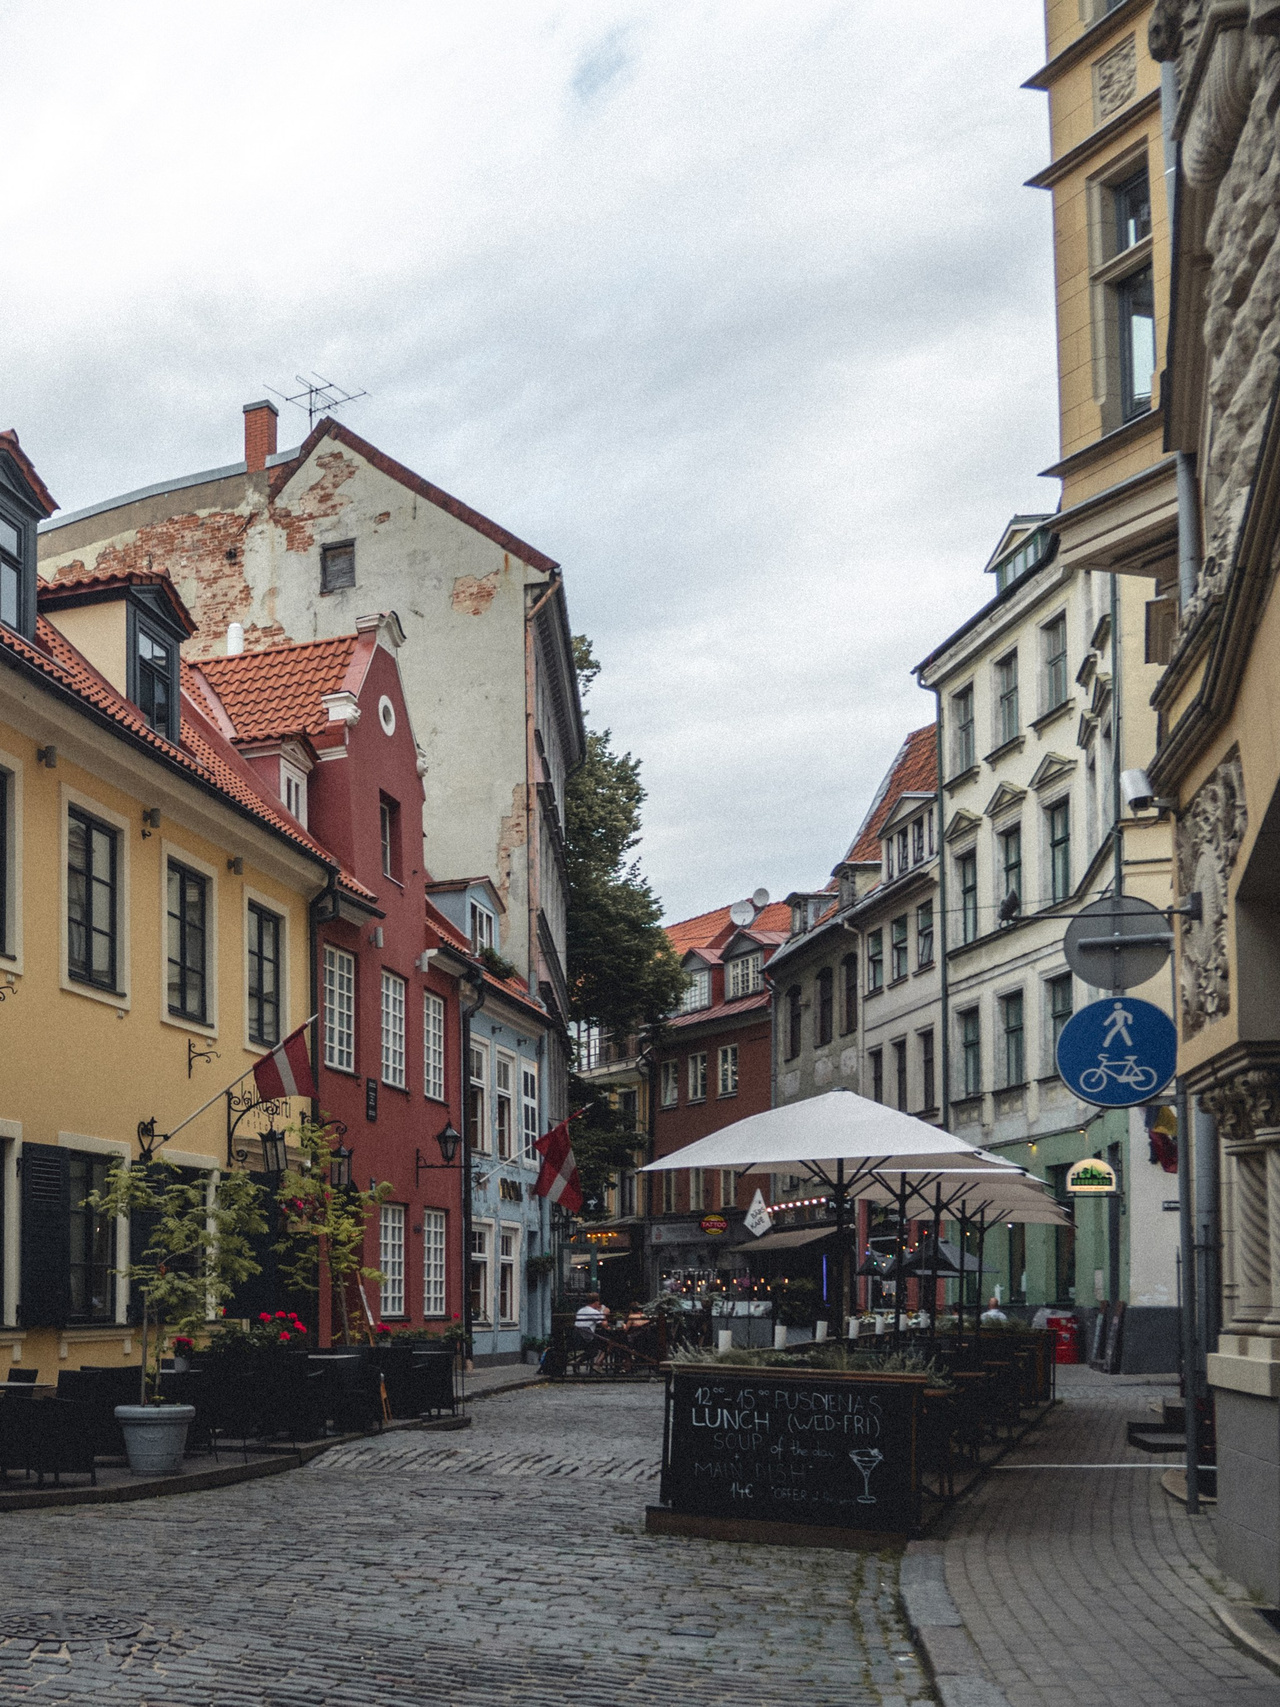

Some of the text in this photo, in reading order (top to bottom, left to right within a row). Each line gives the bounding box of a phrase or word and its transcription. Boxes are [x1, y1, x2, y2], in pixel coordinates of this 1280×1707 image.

[701, 1221, 727, 1229] TATTOO
[692, 1408, 769, 1433] LUNCH
[713, 1432, 763, 1451] SOUP
[770, 1436, 783, 1460] of
[790, 1440, 808, 1456] the
[694, 1462, 742, 1480] MAIN
[730, 1482, 754, 1499] 14€
